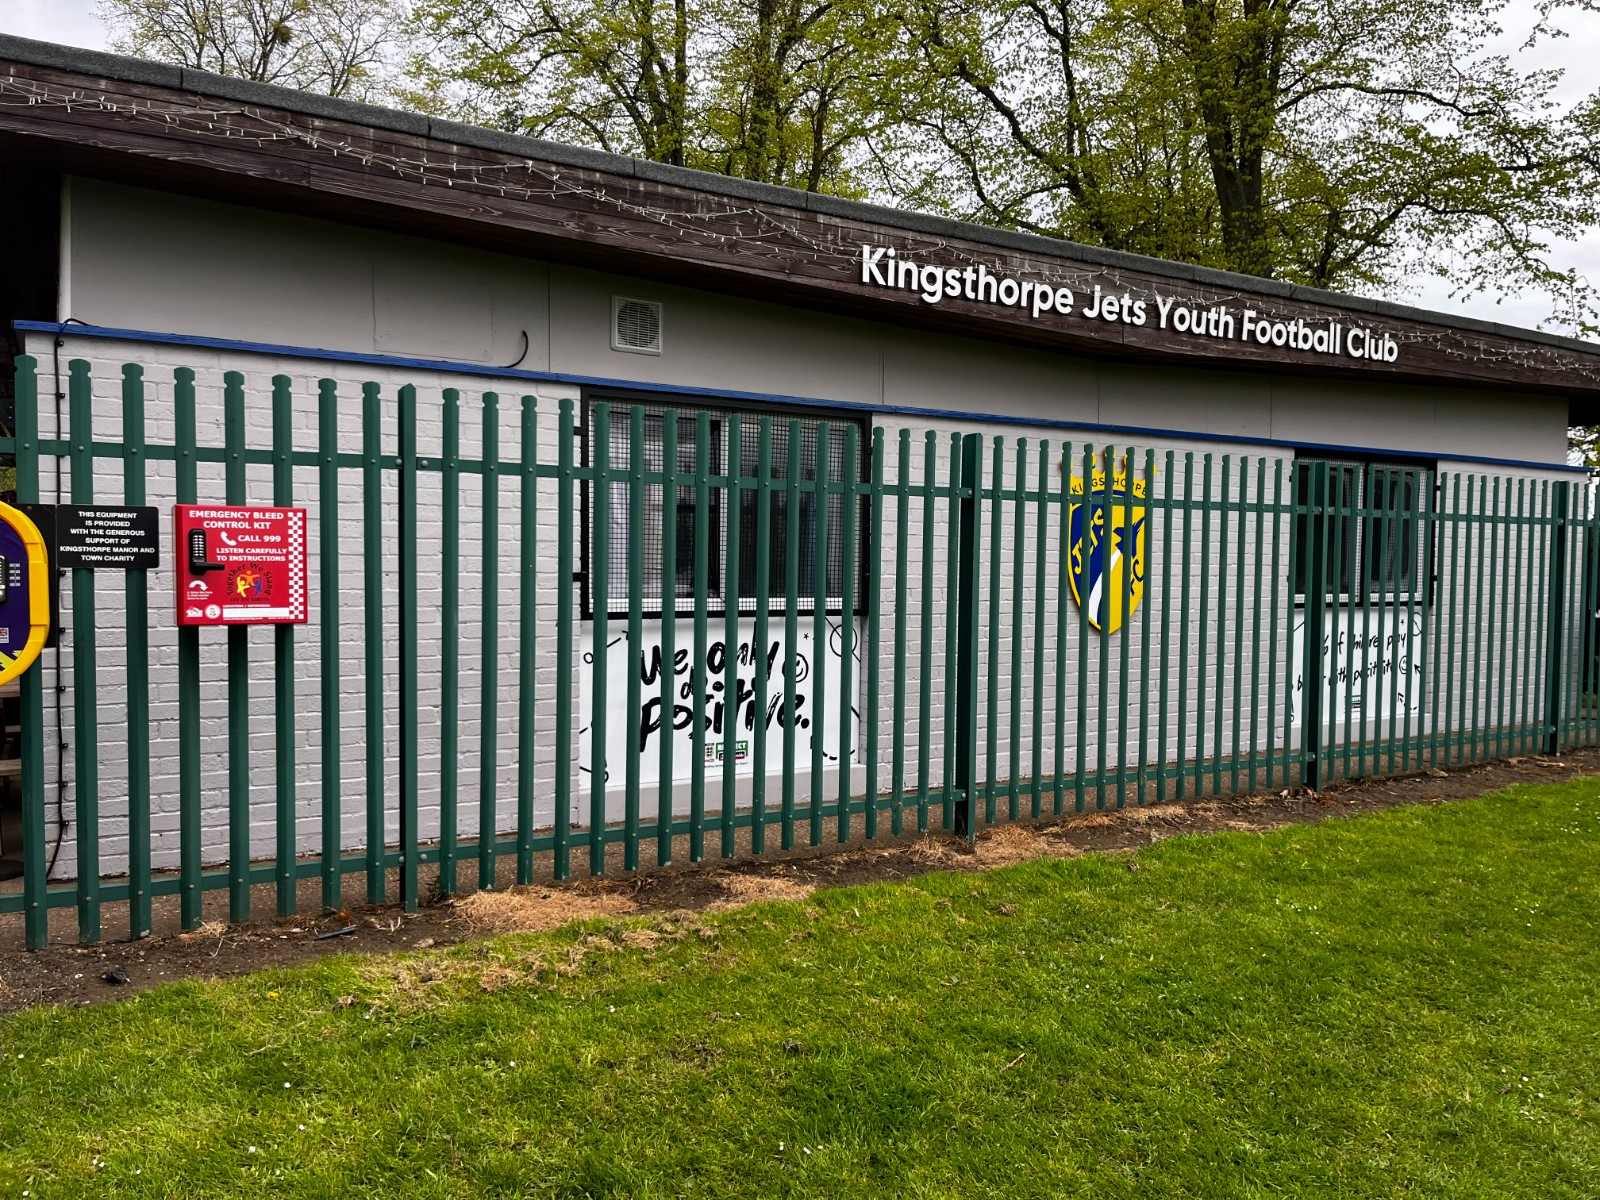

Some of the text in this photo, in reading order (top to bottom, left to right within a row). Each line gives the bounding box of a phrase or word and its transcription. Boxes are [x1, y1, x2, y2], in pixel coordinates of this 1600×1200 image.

[862, 245, 1399, 363] Kingsthorpe Jets Youth Football Club
[96, 511, 138, 519] EQUIPMENT
[189, 510, 284, 520] EMERGENCY BLEED
[203, 520, 271, 529] CONTROL KIT
[263, 535, 281, 543] 999
[59, 545, 111, 553] KINGSTHORPE
[226, 562, 273, 596] Together We Stand
